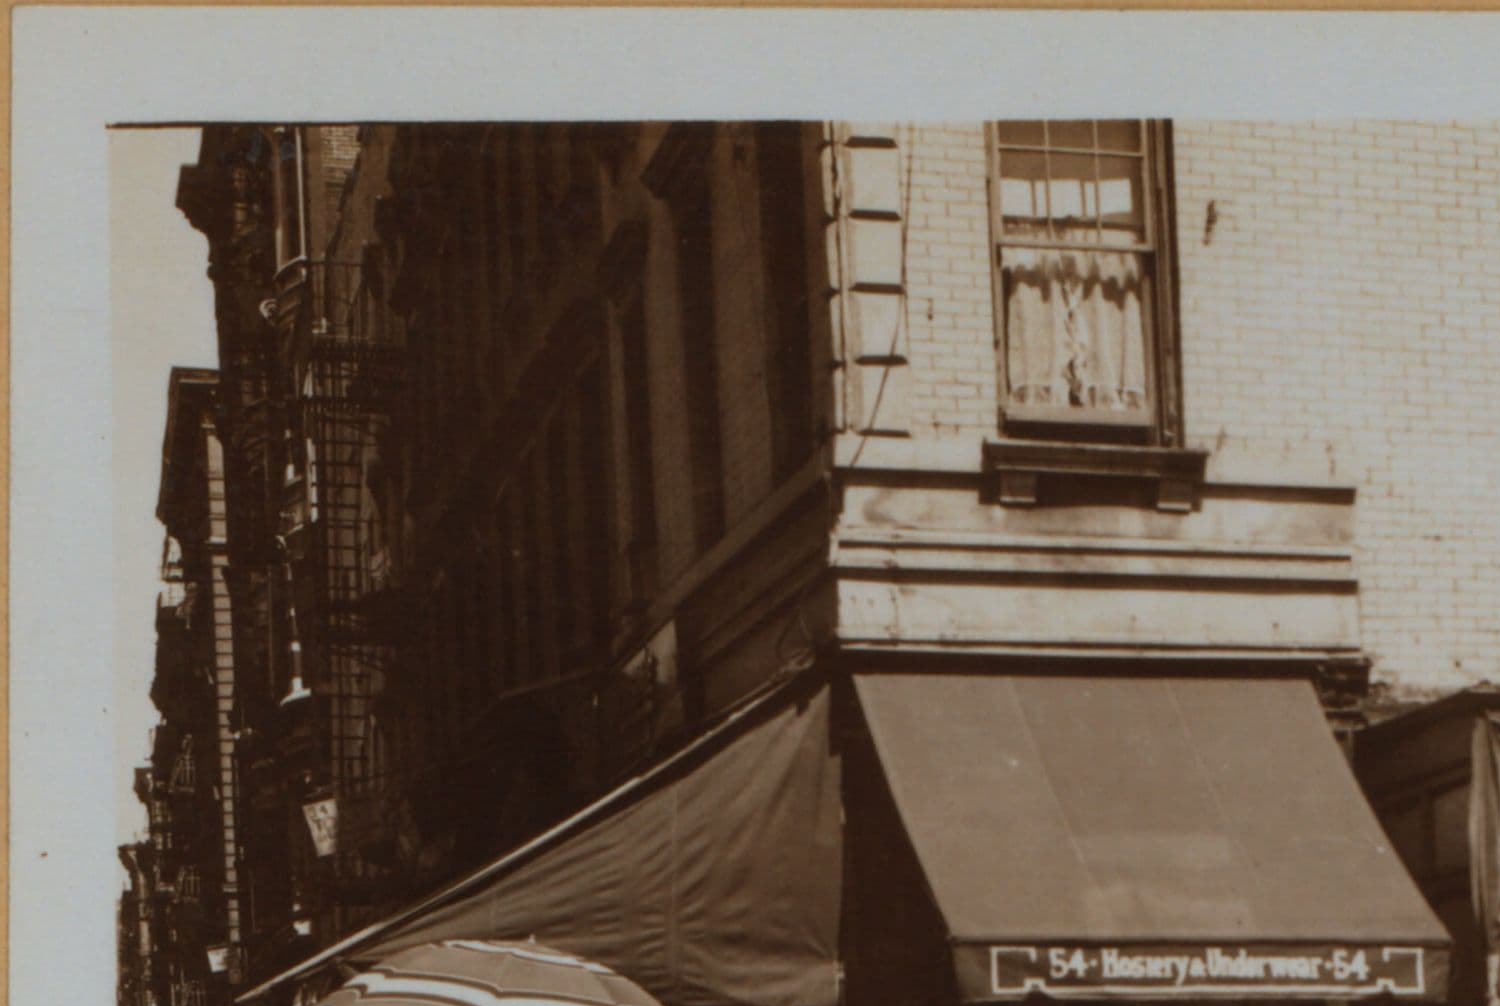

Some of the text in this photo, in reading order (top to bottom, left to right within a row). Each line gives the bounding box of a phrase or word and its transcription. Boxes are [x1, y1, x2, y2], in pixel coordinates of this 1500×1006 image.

[1050, 948, 1088, 980] 54
[1102, 947, 1190, 987] Hosiery
[1206, 947, 1323, 979] Underwear
[1332, 948, 1371, 981] 54
